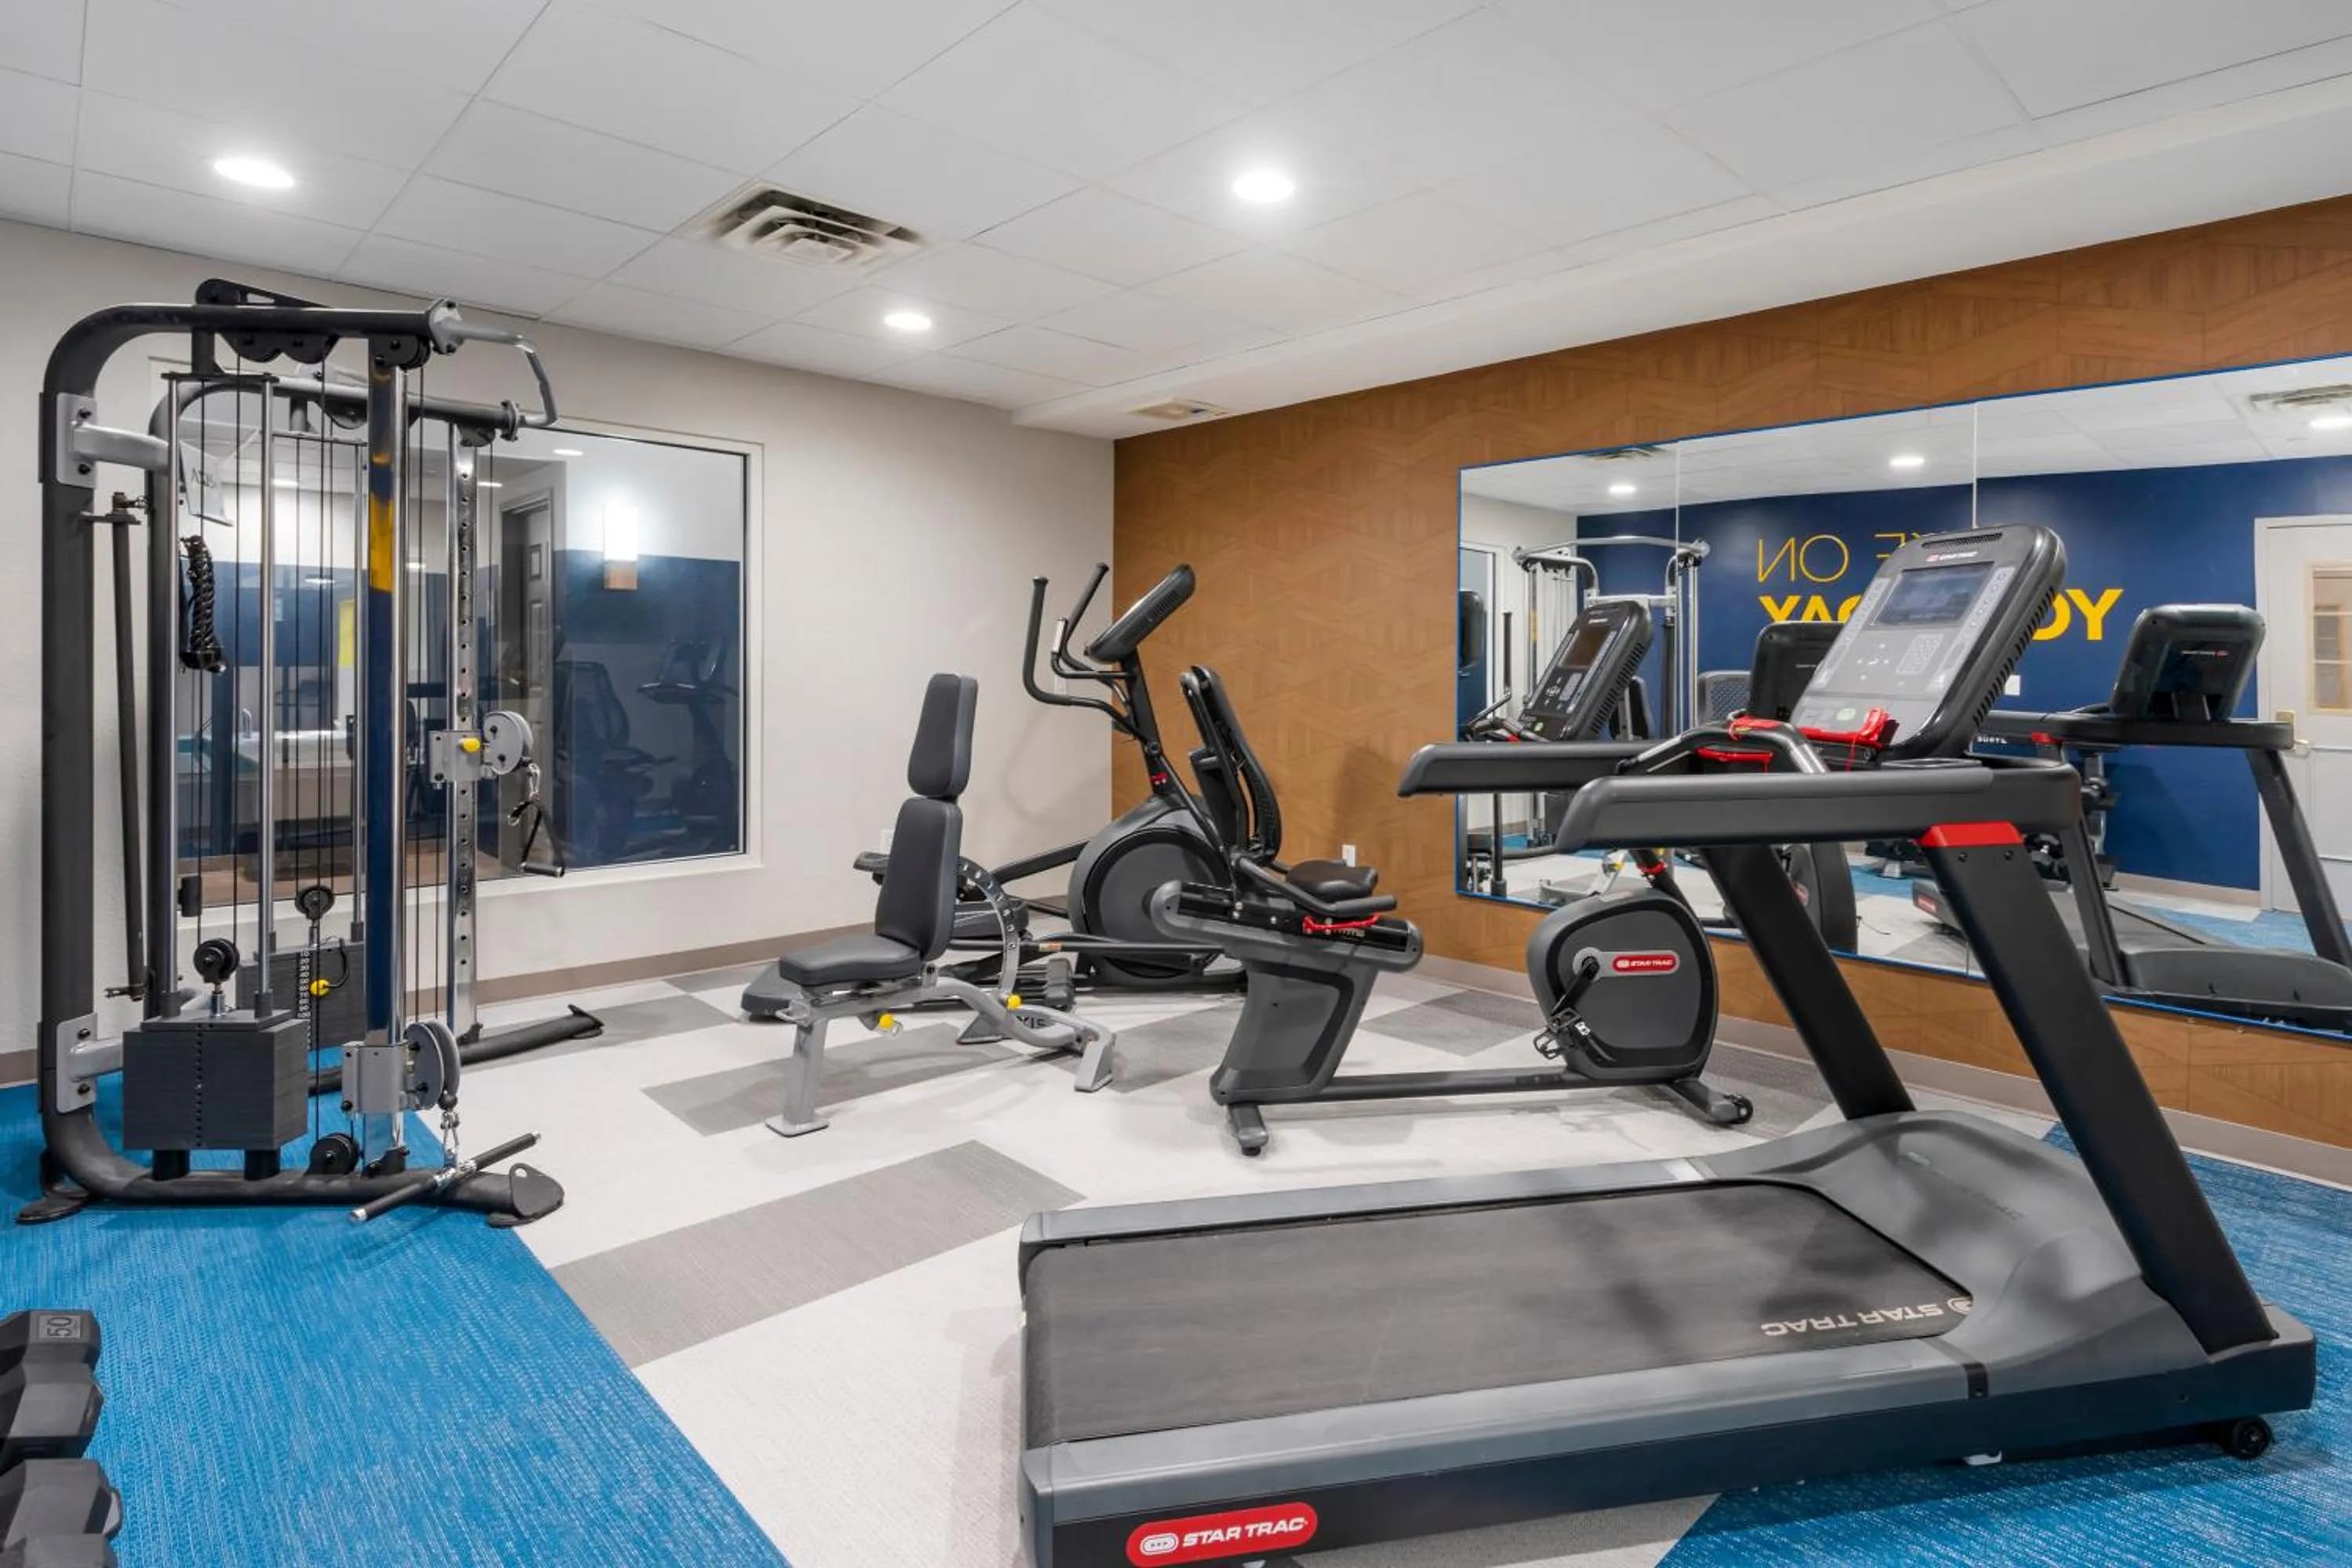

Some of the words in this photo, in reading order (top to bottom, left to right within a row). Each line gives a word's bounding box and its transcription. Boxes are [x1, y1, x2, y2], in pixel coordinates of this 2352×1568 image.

[1856, 1304, 1944, 1324] STAR
[47, 1316, 72, 1337] 50
[1761, 1314, 1858, 1337] TRAC
[1182, 1526, 1242, 1548] STAR
[1244, 1517, 1305, 1537] TRAC
